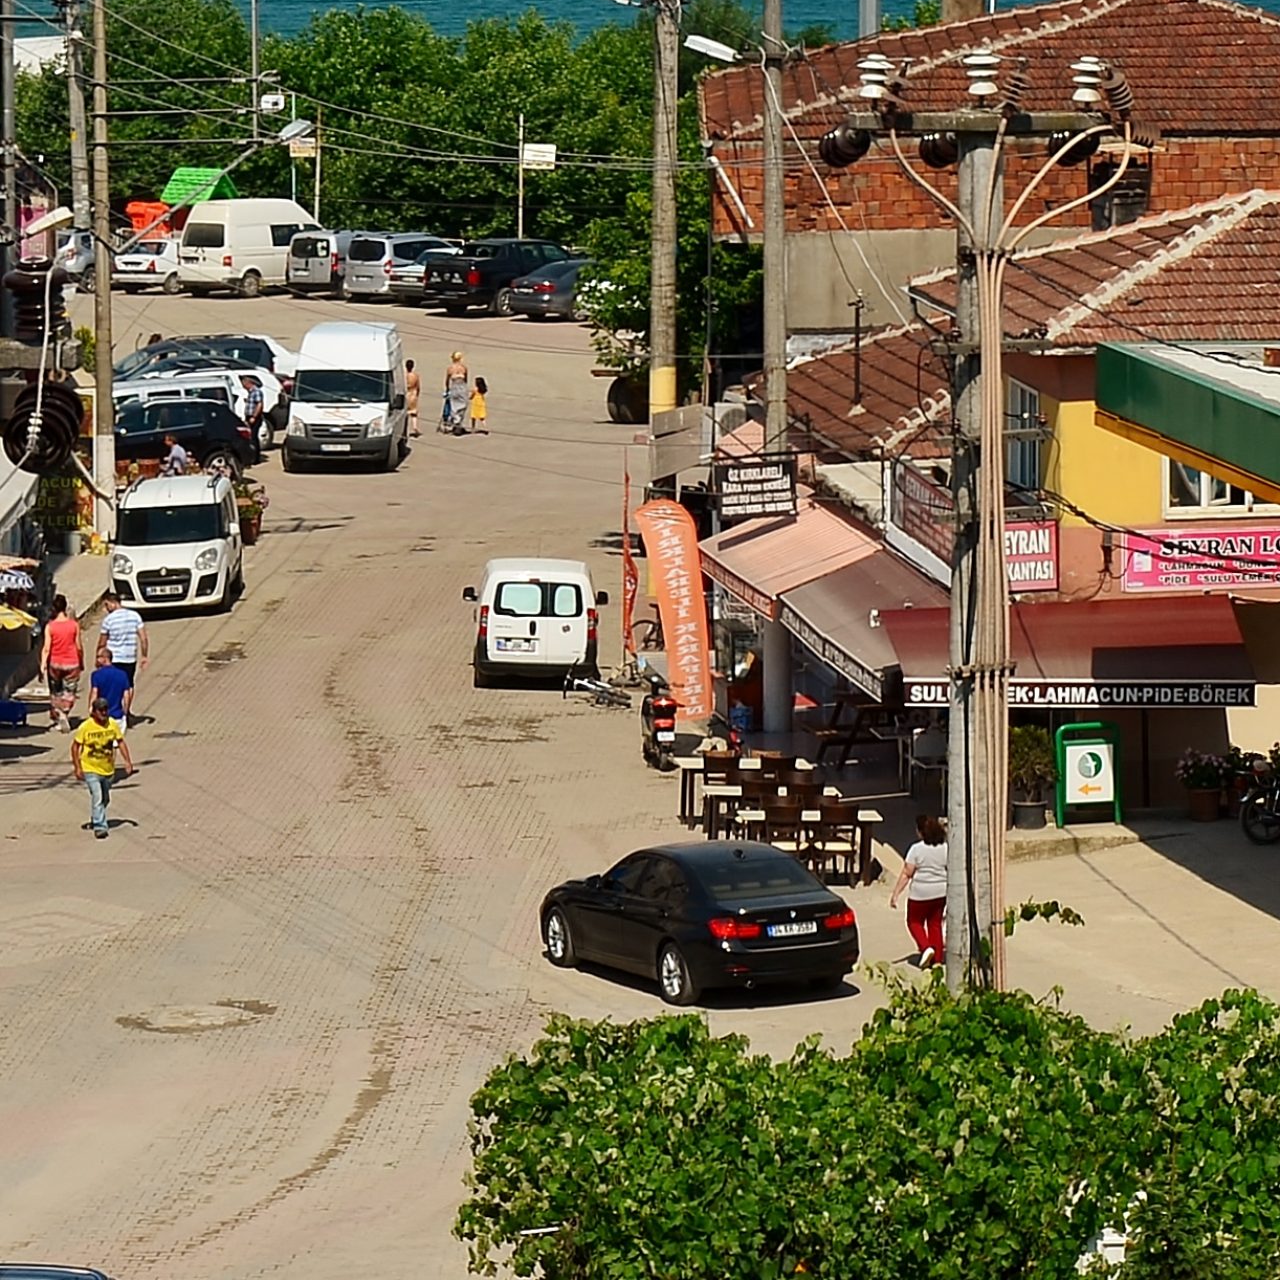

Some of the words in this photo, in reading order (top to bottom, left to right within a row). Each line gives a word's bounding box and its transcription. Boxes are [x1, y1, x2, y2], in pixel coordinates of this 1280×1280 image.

[1004, 528, 1050, 556] EYRAN
[1161, 537, 1254, 557] SEYRAN
[1006, 560, 1054, 582] KANTASI
[1204, 574, 1232, 583] SULU
